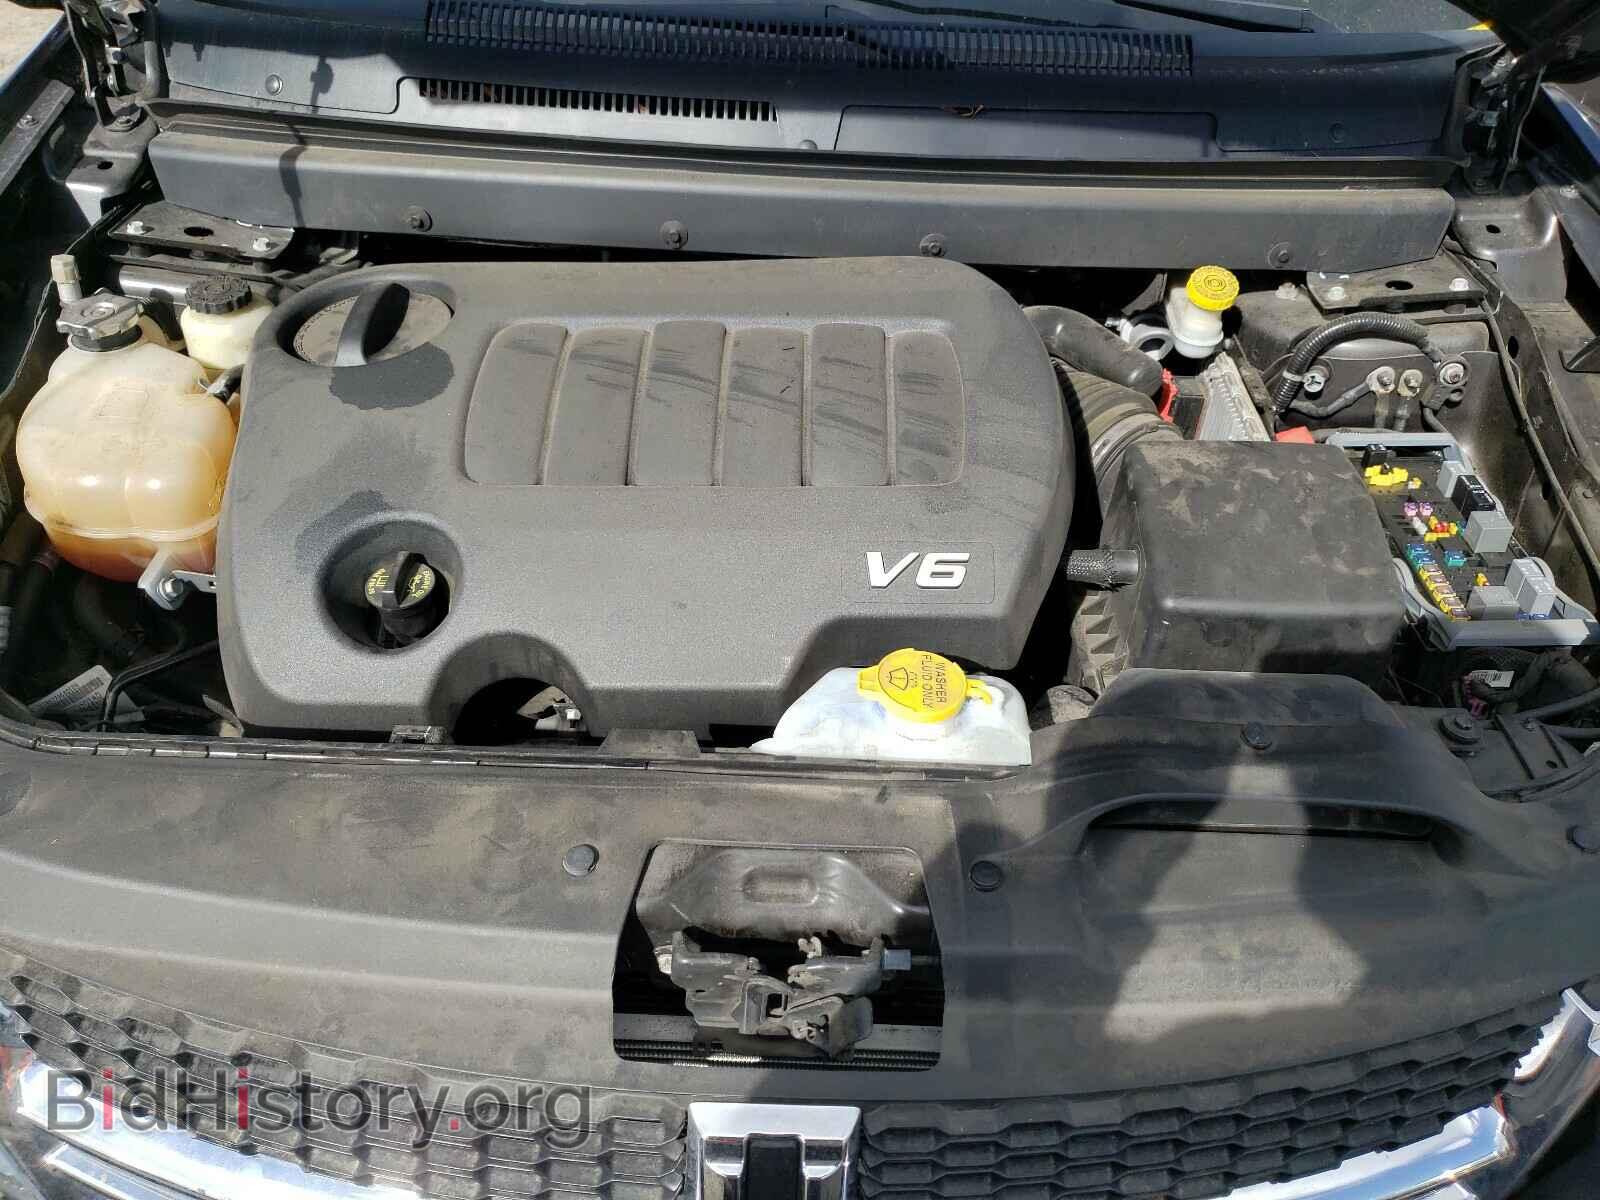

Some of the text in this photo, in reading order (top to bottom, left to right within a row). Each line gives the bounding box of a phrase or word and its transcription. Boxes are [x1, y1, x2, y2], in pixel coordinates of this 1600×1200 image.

[865, 551, 970, 589] V6
[921, 654, 935, 711] FLUID ONLY
[935, 662, 947, 703] WASHER
